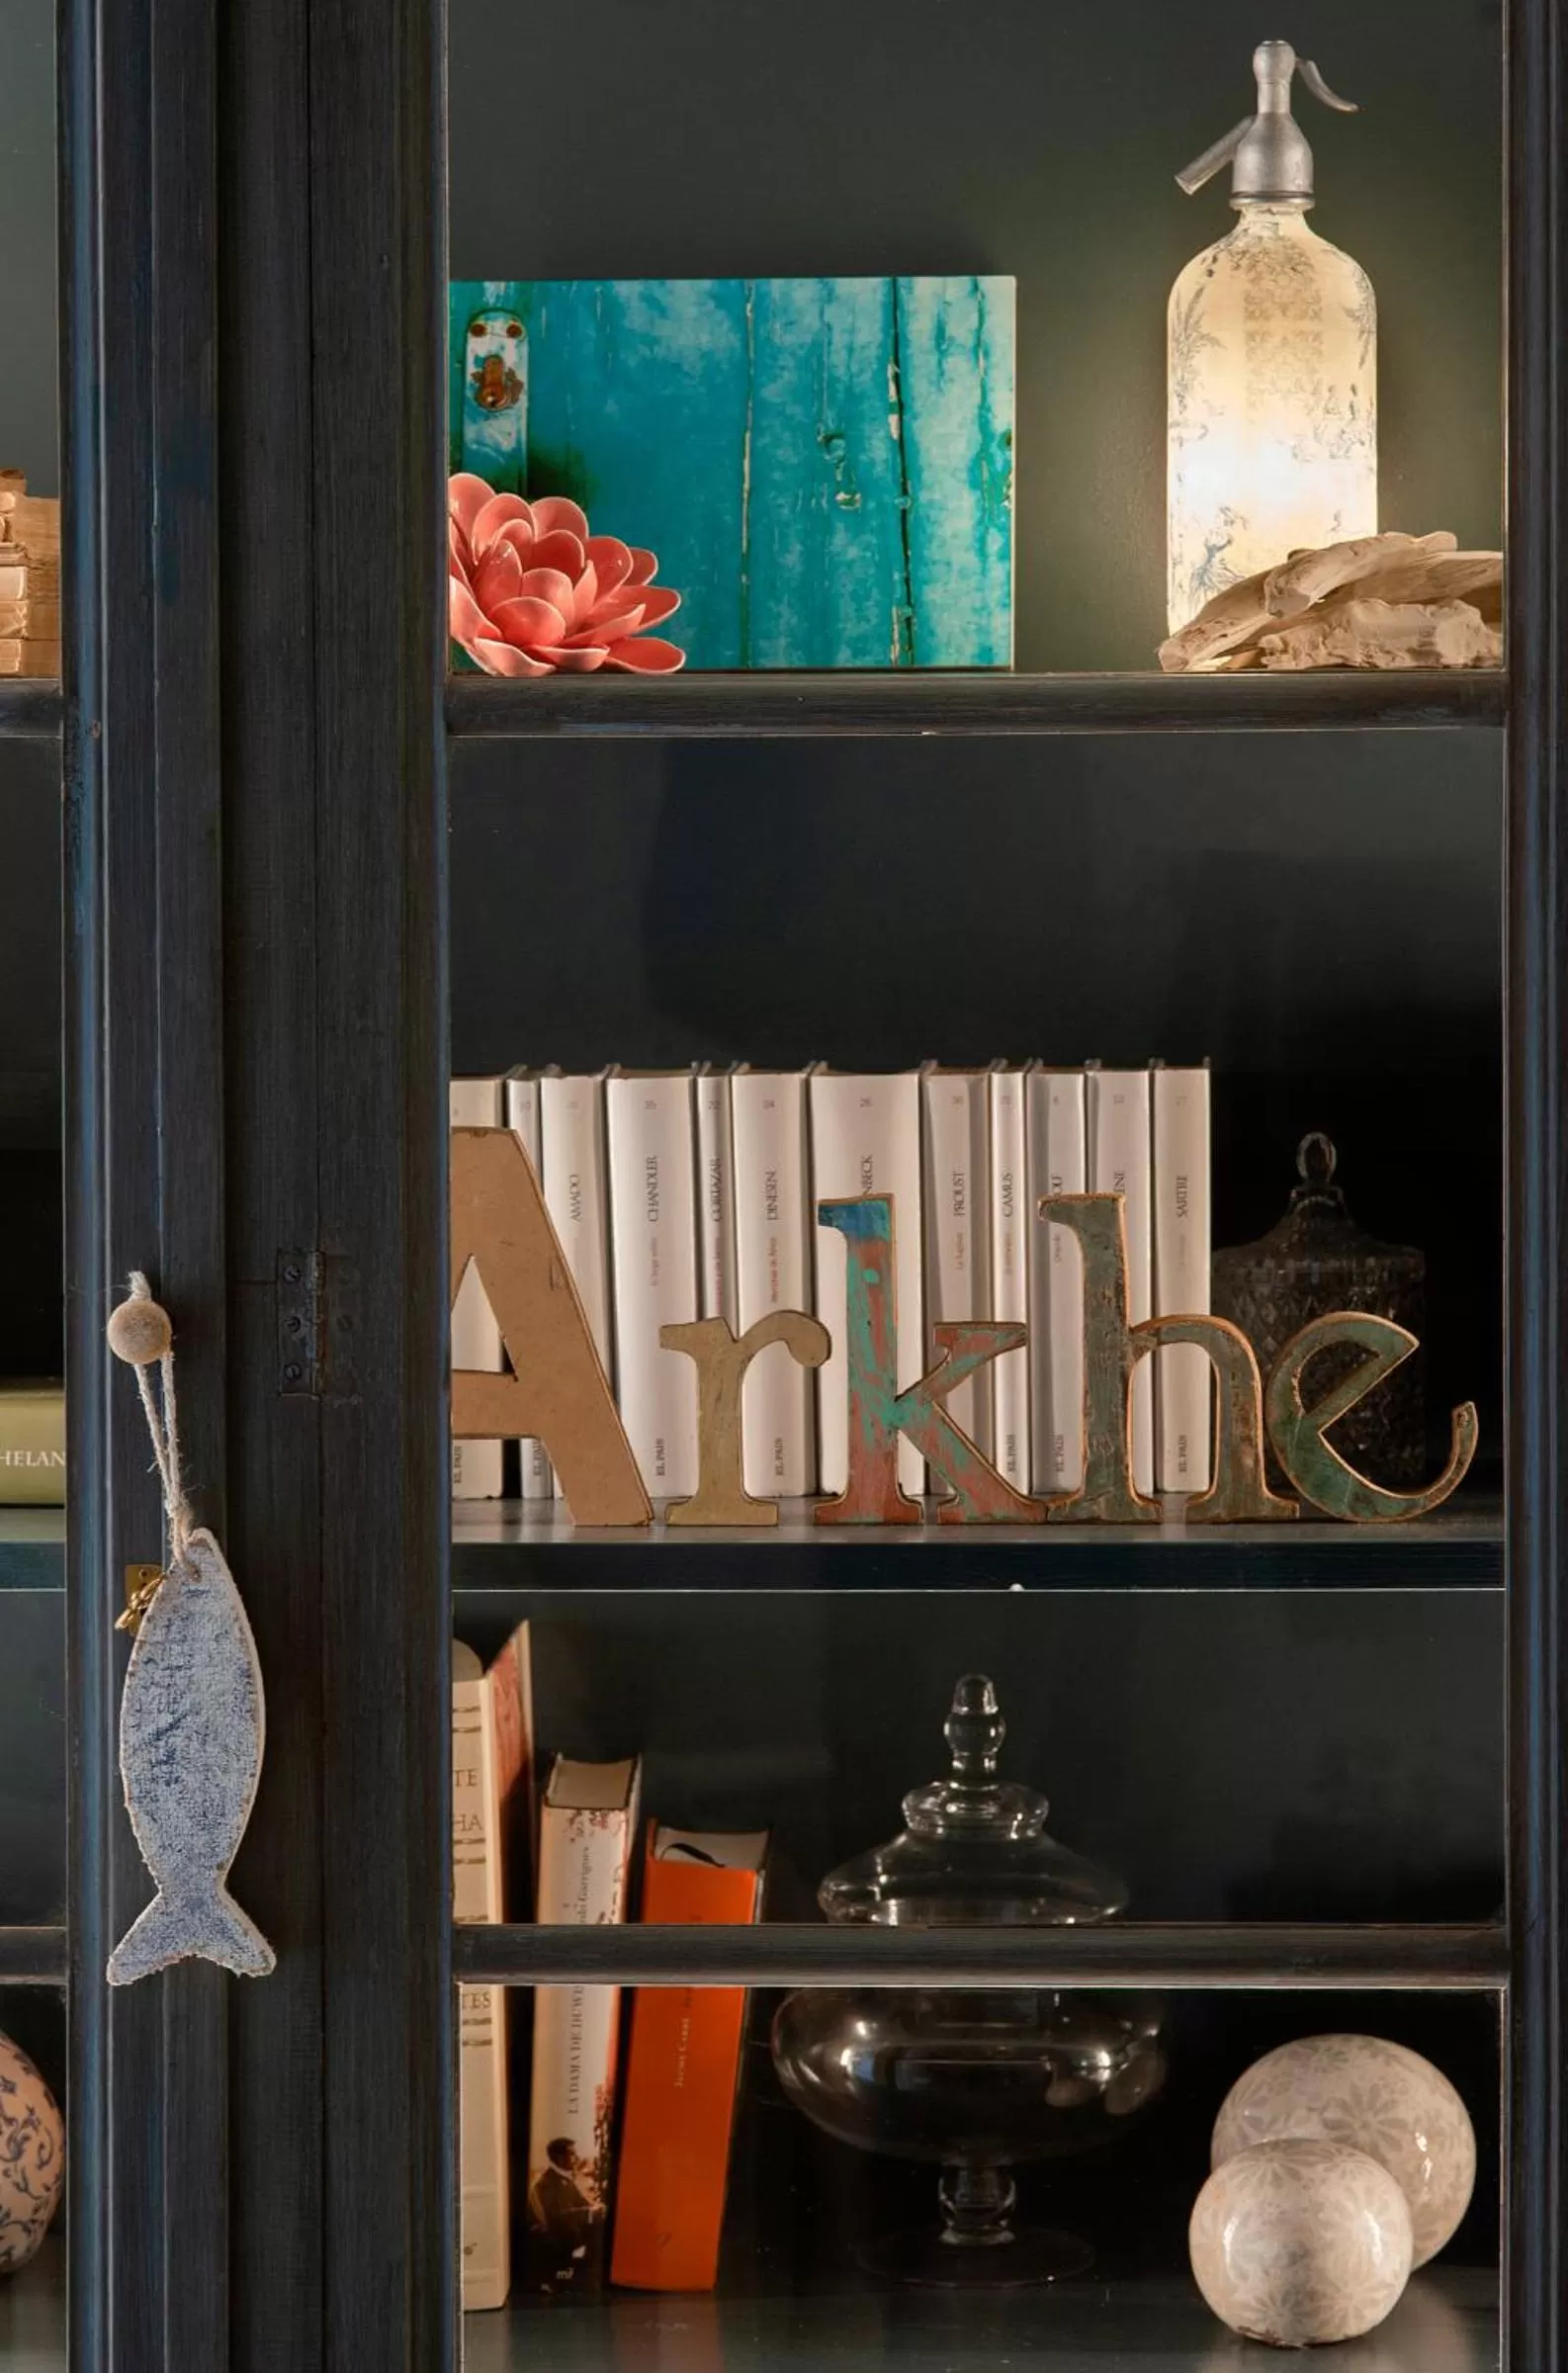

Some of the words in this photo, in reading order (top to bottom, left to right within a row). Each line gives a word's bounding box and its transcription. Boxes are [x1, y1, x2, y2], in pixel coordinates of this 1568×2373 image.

[646, 1155, 658, 1223] CHANDLER
[765, 1171, 779, 1221] DINESEN
[861, 1154, 873, 1195] NBECK
[951, 1171, 965, 1217] PROUST
[1002, 1172, 1014, 1218] CAMUS
[568, 1174, 581, 1223] AMADO
[1176, 1175, 1187, 1218] SARTRE
[451, 1127, 1479, 1526] Arkhe
[0, 1450, 65, 1466] HELAN
[455, 1768, 479, 1788] TE
[455, 1813, 483, 1831] HA
[569, 2033, 582, 2052] DE
[568, 2055, 580, 2093] DAMA
